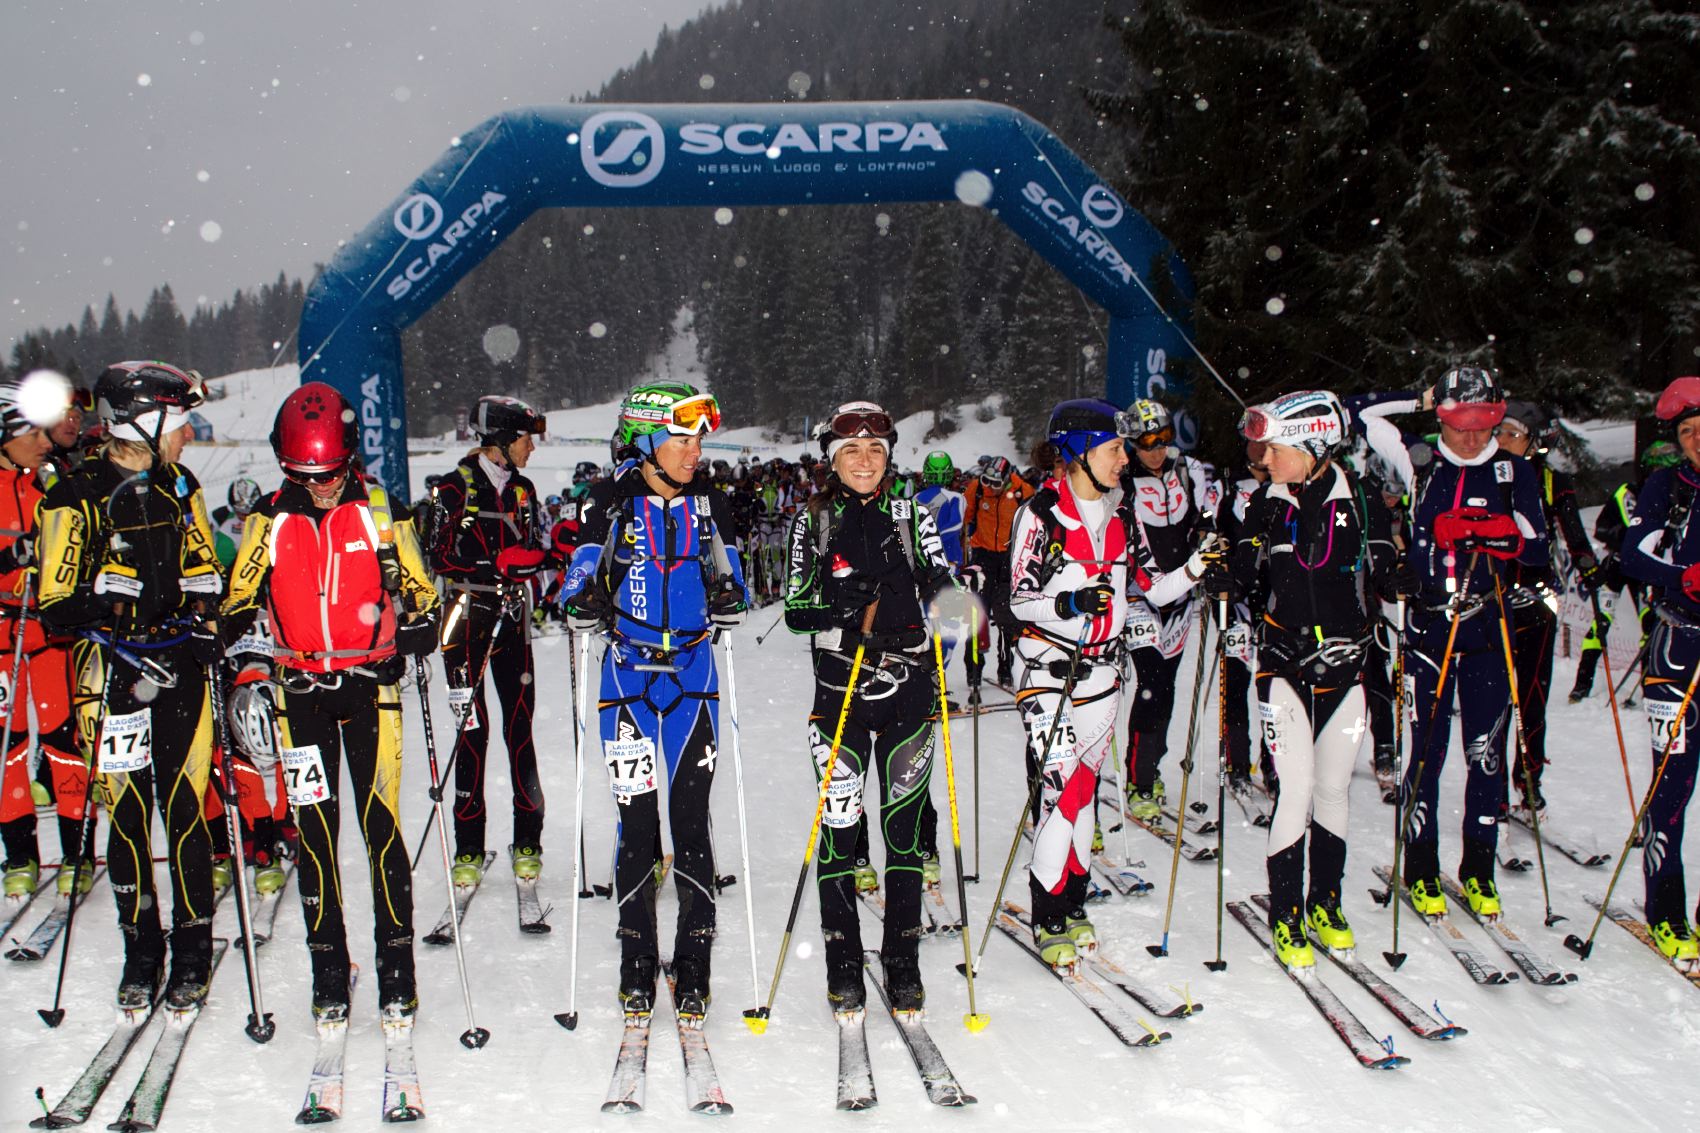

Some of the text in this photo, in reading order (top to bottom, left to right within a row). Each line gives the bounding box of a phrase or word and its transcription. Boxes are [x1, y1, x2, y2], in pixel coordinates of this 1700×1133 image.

[679, 122, 949, 154] SCARPA
[698, 163, 762, 174] NESSUN
[386, 190, 507, 301] SCARPA
[1021, 181, 1132, 285] SCARPA
[632, 393, 674, 406] CAMP
[361, 373, 386, 488] ARPA
[629, 516, 647, 621] ESERCITO
[1225, 633, 1246, 647] 64
[103, 728, 151, 755] 174
[1036, 725, 1077, 749] 175
[284, 763, 323, 789] 74
[609, 754, 654, 779] 173
[825, 788, 863, 813] 173
